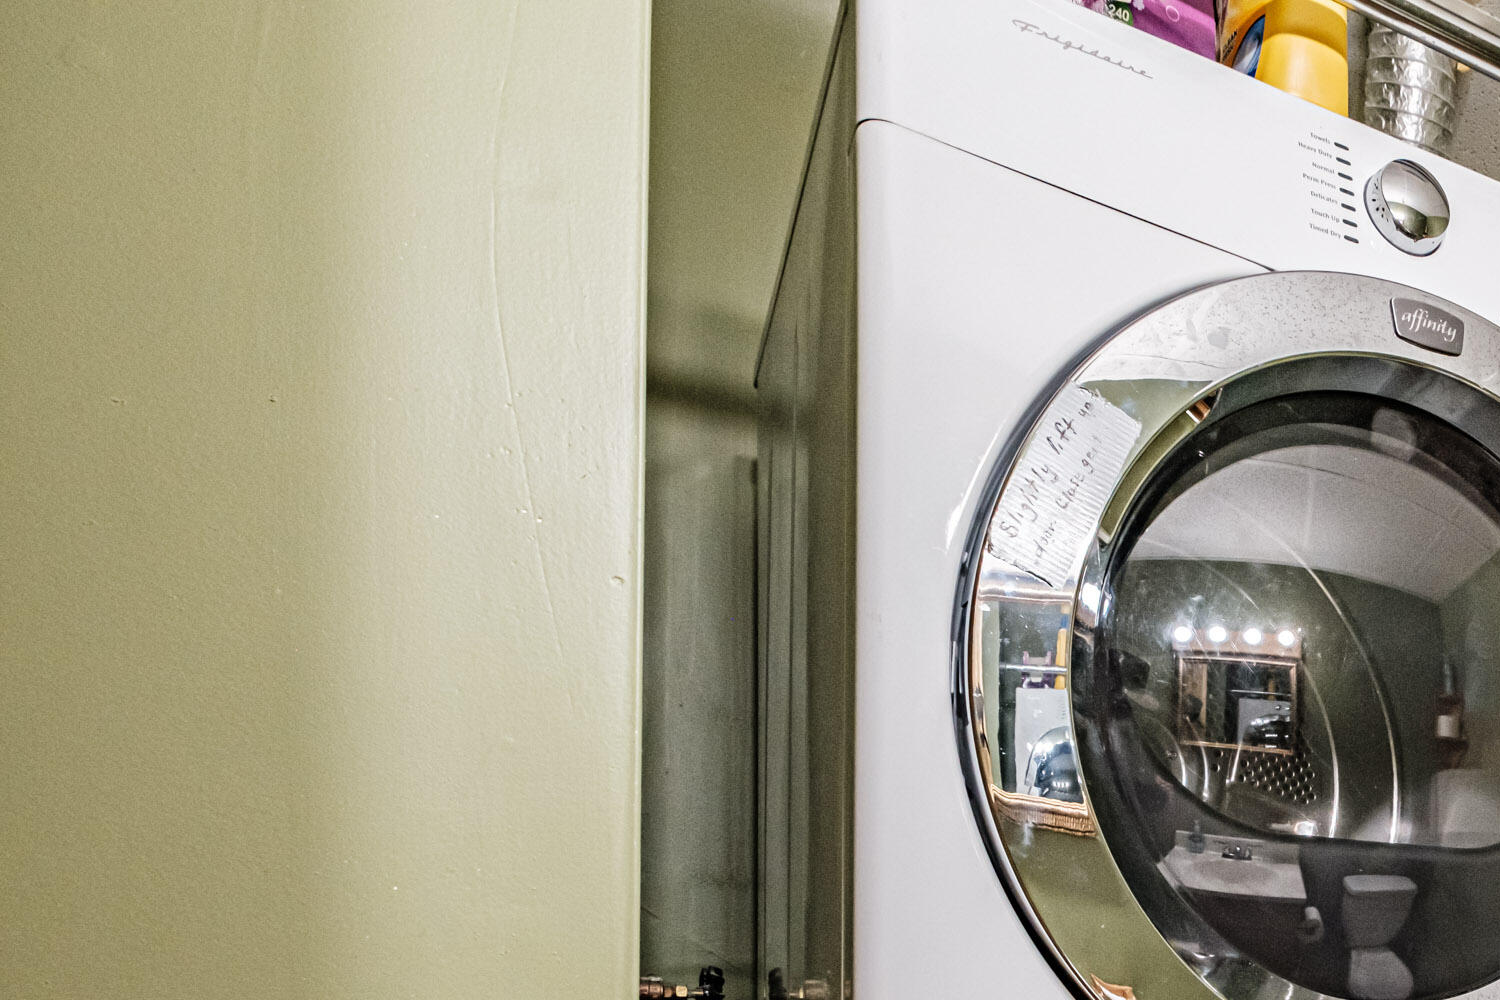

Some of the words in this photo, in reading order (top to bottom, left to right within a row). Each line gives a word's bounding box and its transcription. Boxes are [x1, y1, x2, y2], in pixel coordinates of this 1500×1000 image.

[1108, 4, 1130, 22] 240
[1011, 19, 1154, 80] Frigidaire
[1312, 162, 1334, 174] Normal
[1302, 172, 1319, 183] Perm
[1311, 208, 1330, 220] Touch
[1401, 308, 1457, 342] affinity
[1046, 417, 1078, 456] lift
